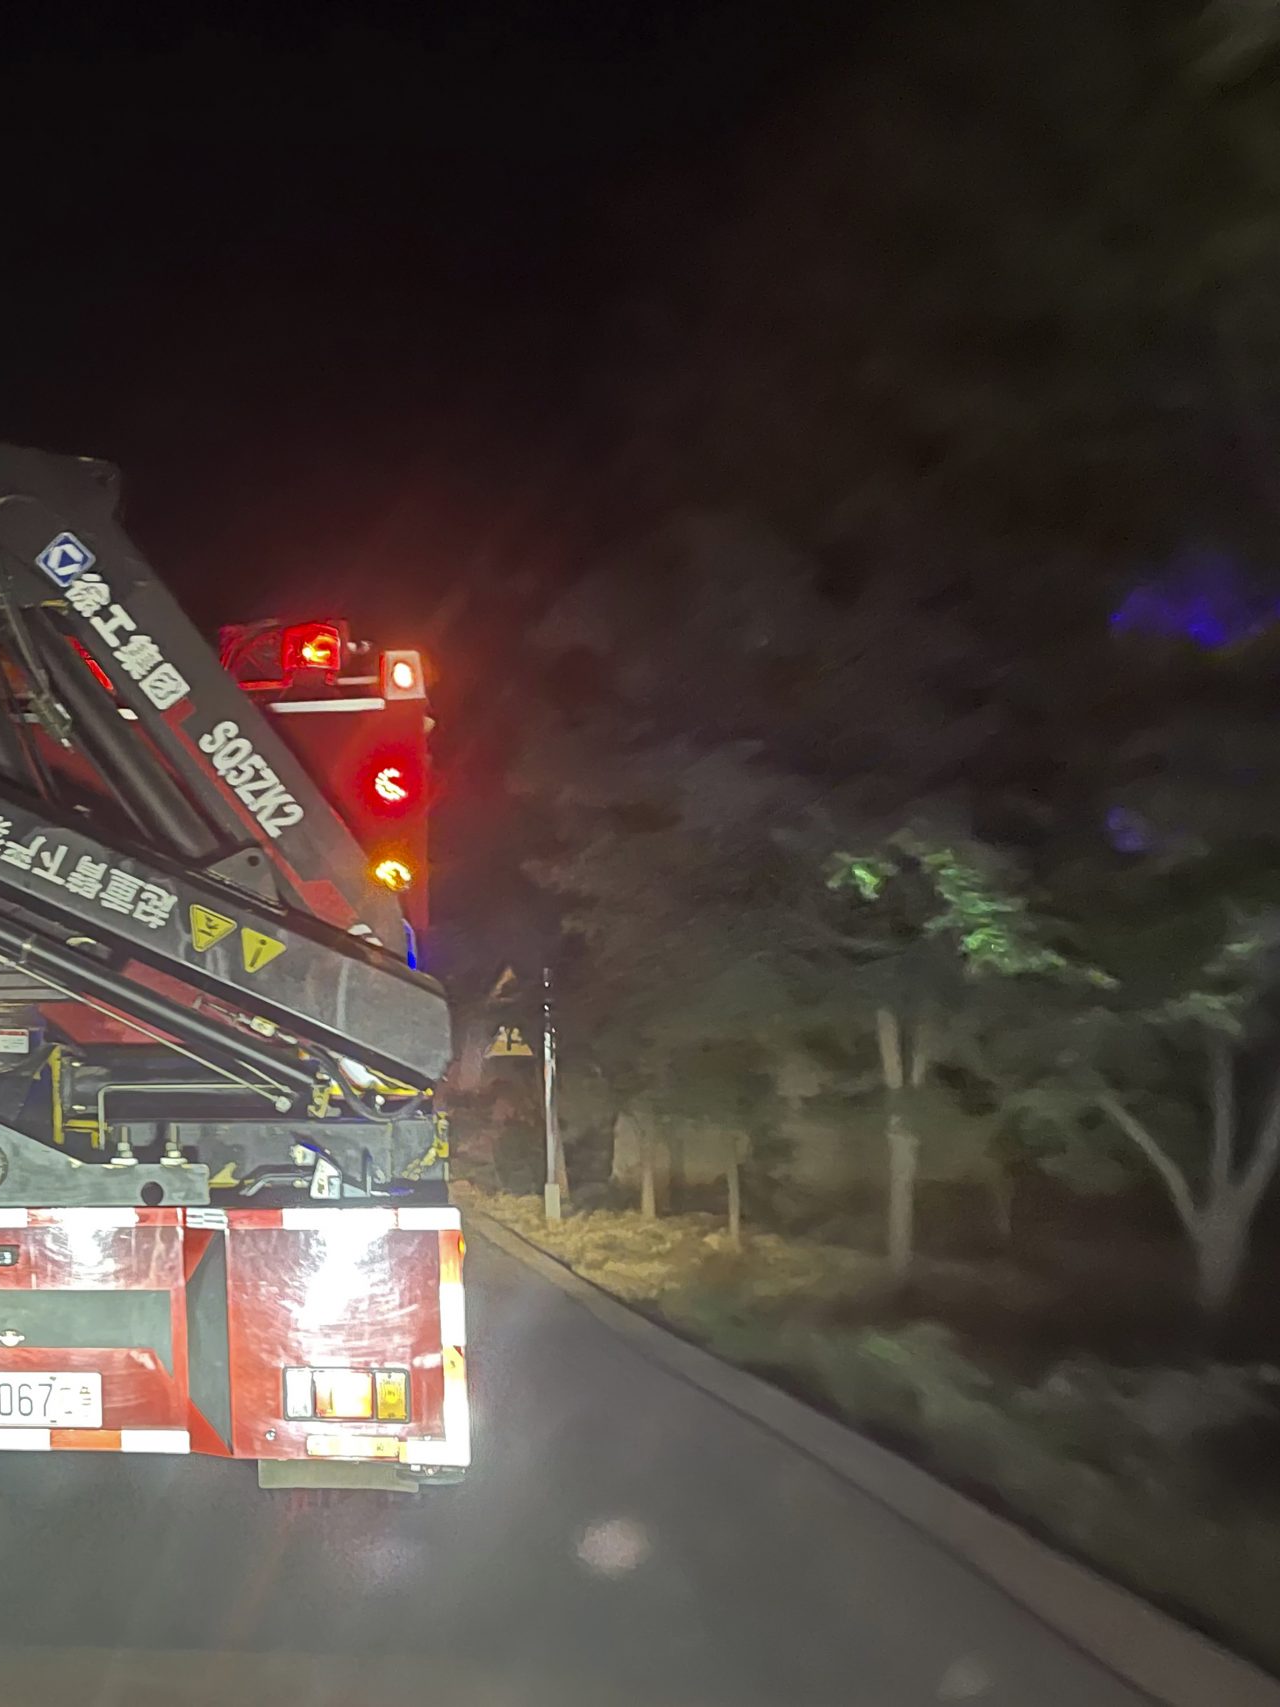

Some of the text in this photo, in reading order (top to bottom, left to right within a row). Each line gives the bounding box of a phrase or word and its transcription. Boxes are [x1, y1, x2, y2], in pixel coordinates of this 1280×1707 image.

[65, 573, 191, 710] 徐工集团
[199, 721, 304, 838] SQ5ZK2
